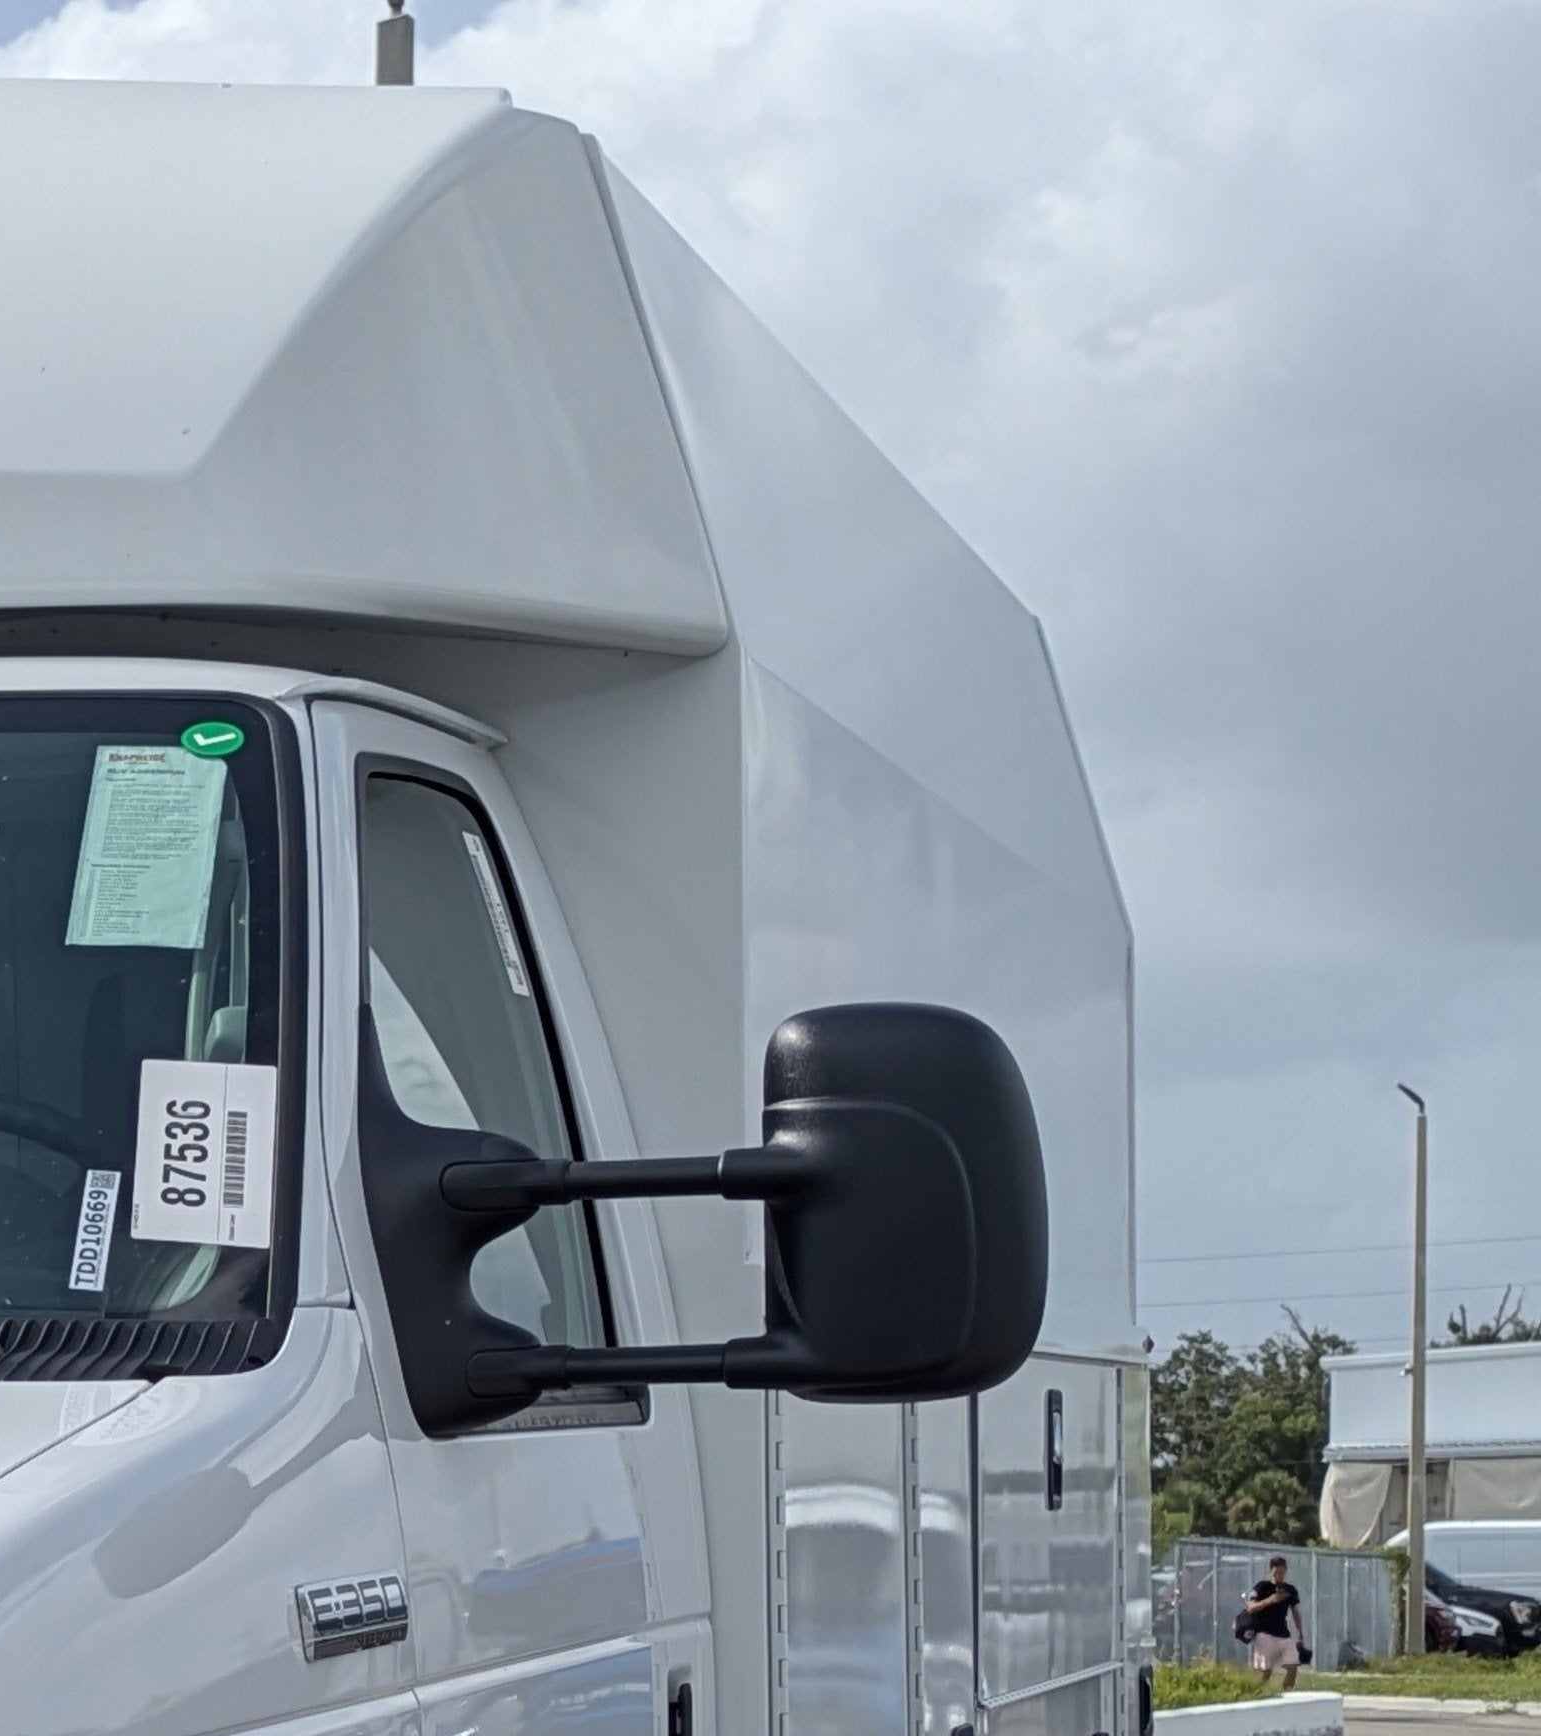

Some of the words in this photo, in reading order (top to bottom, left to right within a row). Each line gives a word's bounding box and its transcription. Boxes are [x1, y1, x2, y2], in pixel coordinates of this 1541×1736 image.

[160, 1099, 211, 1207] 87536
[75, 1190, 108, 1286] TDD10669
[306, 1575, 409, 1632] E-350
